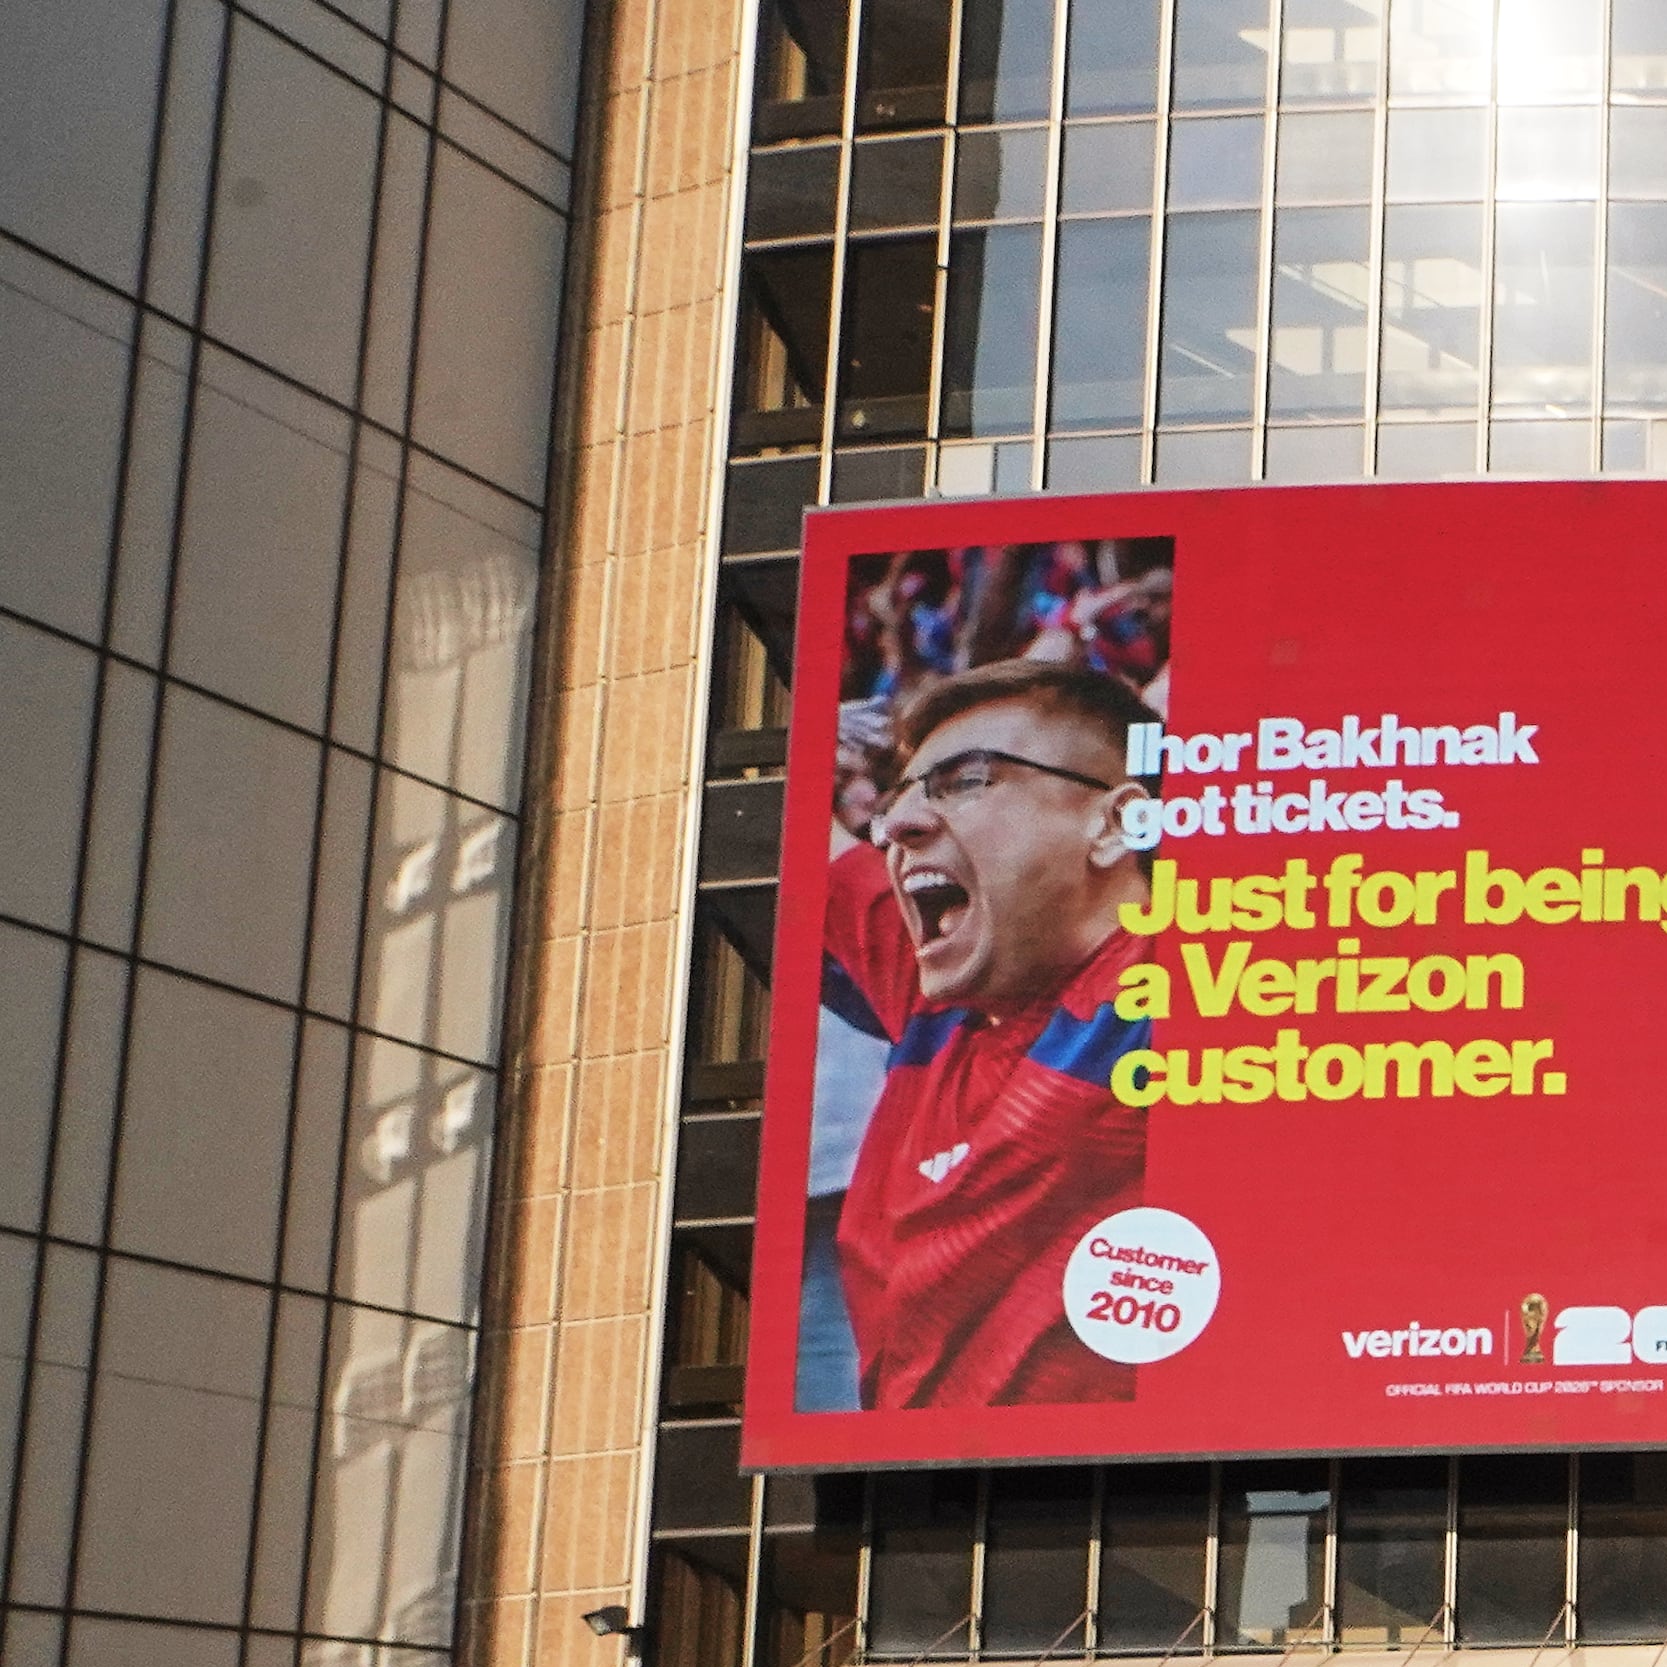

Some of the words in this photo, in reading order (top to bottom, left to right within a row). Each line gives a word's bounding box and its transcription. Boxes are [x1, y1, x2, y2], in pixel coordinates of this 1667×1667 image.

[1126, 722, 1253, 776] Ihor
[1257, 712, 1539, 772] Bakhnak
[1120, 784, 1226, 851] got
[1231, 779, 1460, 835] tickets.
[1118, 856, 1316, 935] Just
[1322, 853, 1457, 929] for
[1113, 961, 1171, 1021] a
[1180, 938, 1525, 1018] Verizon
[1110, 1029, 1567, 1108] customer.
[1088, 1237, 1211, 1277] Customer
[1110, 1268, 1174, 1295] since
[1085, 1290, 1182, 1333] 2010
[1341, 1321, 1493, 1359] verizon
[1385, 1383, 1441, 1398] OFFICIAL
[1445, 1382, 1472, 1396] FIFA
[1474, 1381, 1522, 1396] WORLD
[1525, 1381, 1552, 1395] CUP
